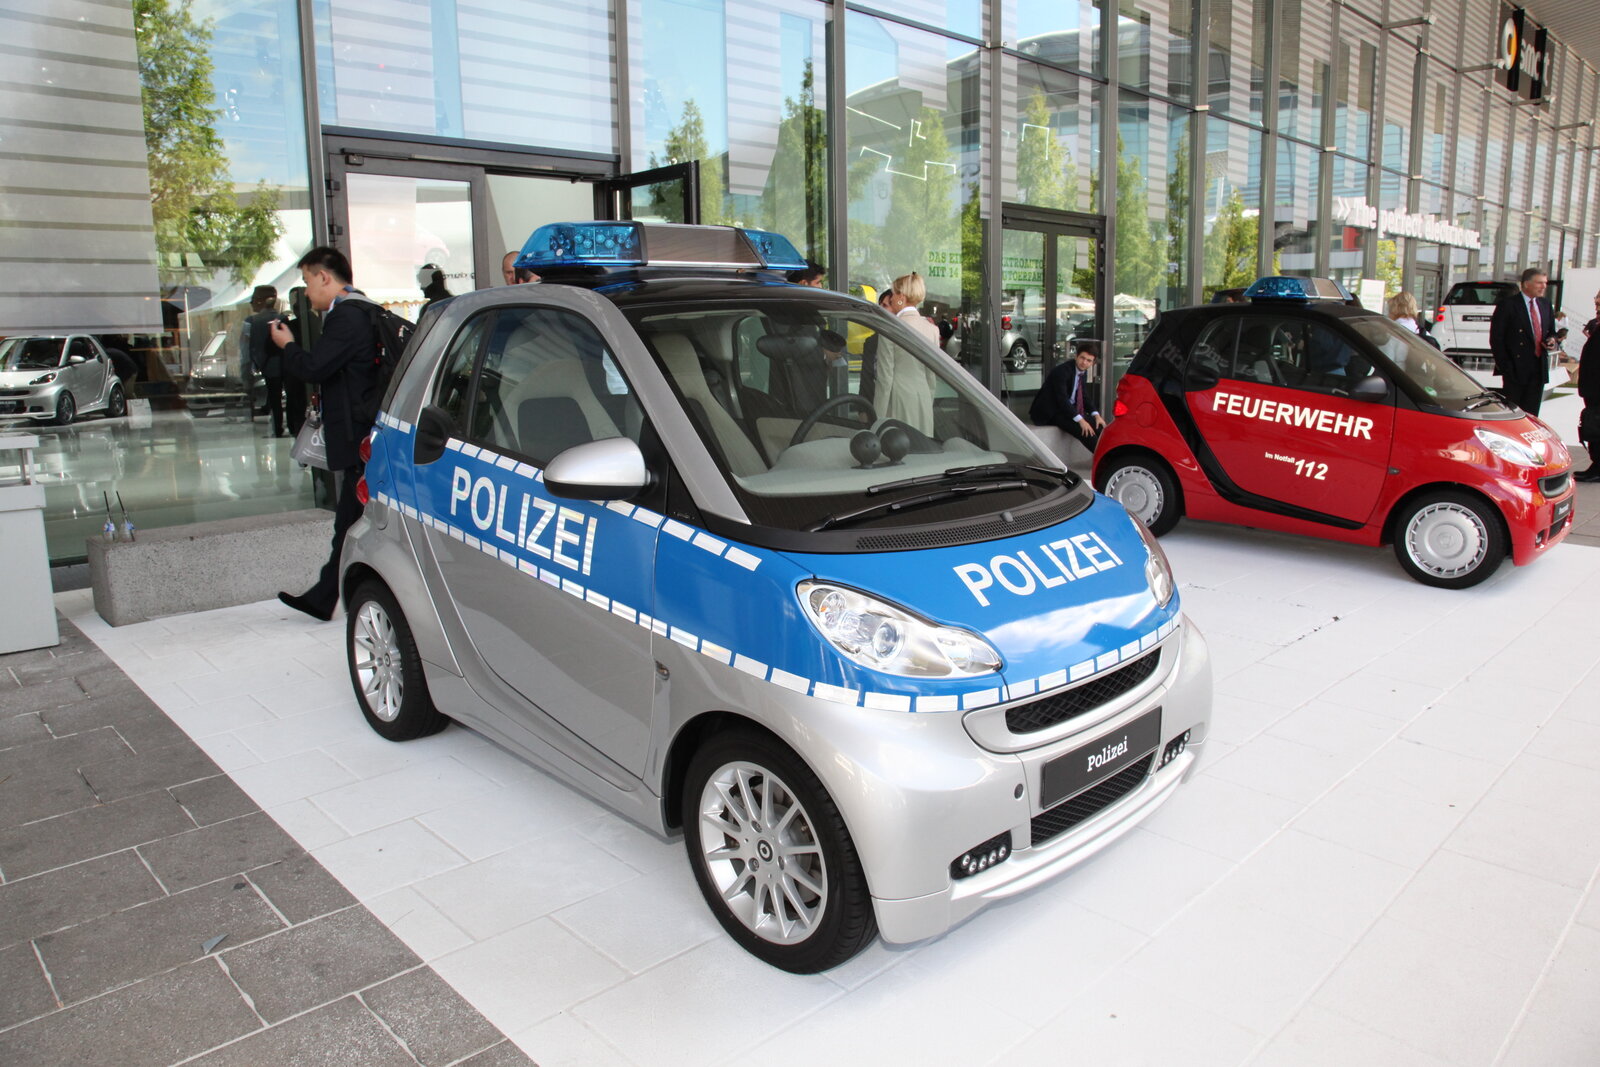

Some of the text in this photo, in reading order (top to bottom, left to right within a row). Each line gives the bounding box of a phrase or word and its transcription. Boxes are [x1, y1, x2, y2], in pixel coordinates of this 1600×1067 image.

[1519, 38, 1550, 87] smt
[1378, 207, 1424, 238] perfect
[928, 251, 947, 263] DAS
[928, 266, 947, 277] MIT
[1212, 391, 1374, 440] FEUERWEHR
[1264, 451, 1329, 481] Im Notfall 112
[450, 465, 598, 576] POLIZEI
[952, 531, 1124, 607] POLIZEI
[1086, 735, 1129, 773] Polizei
